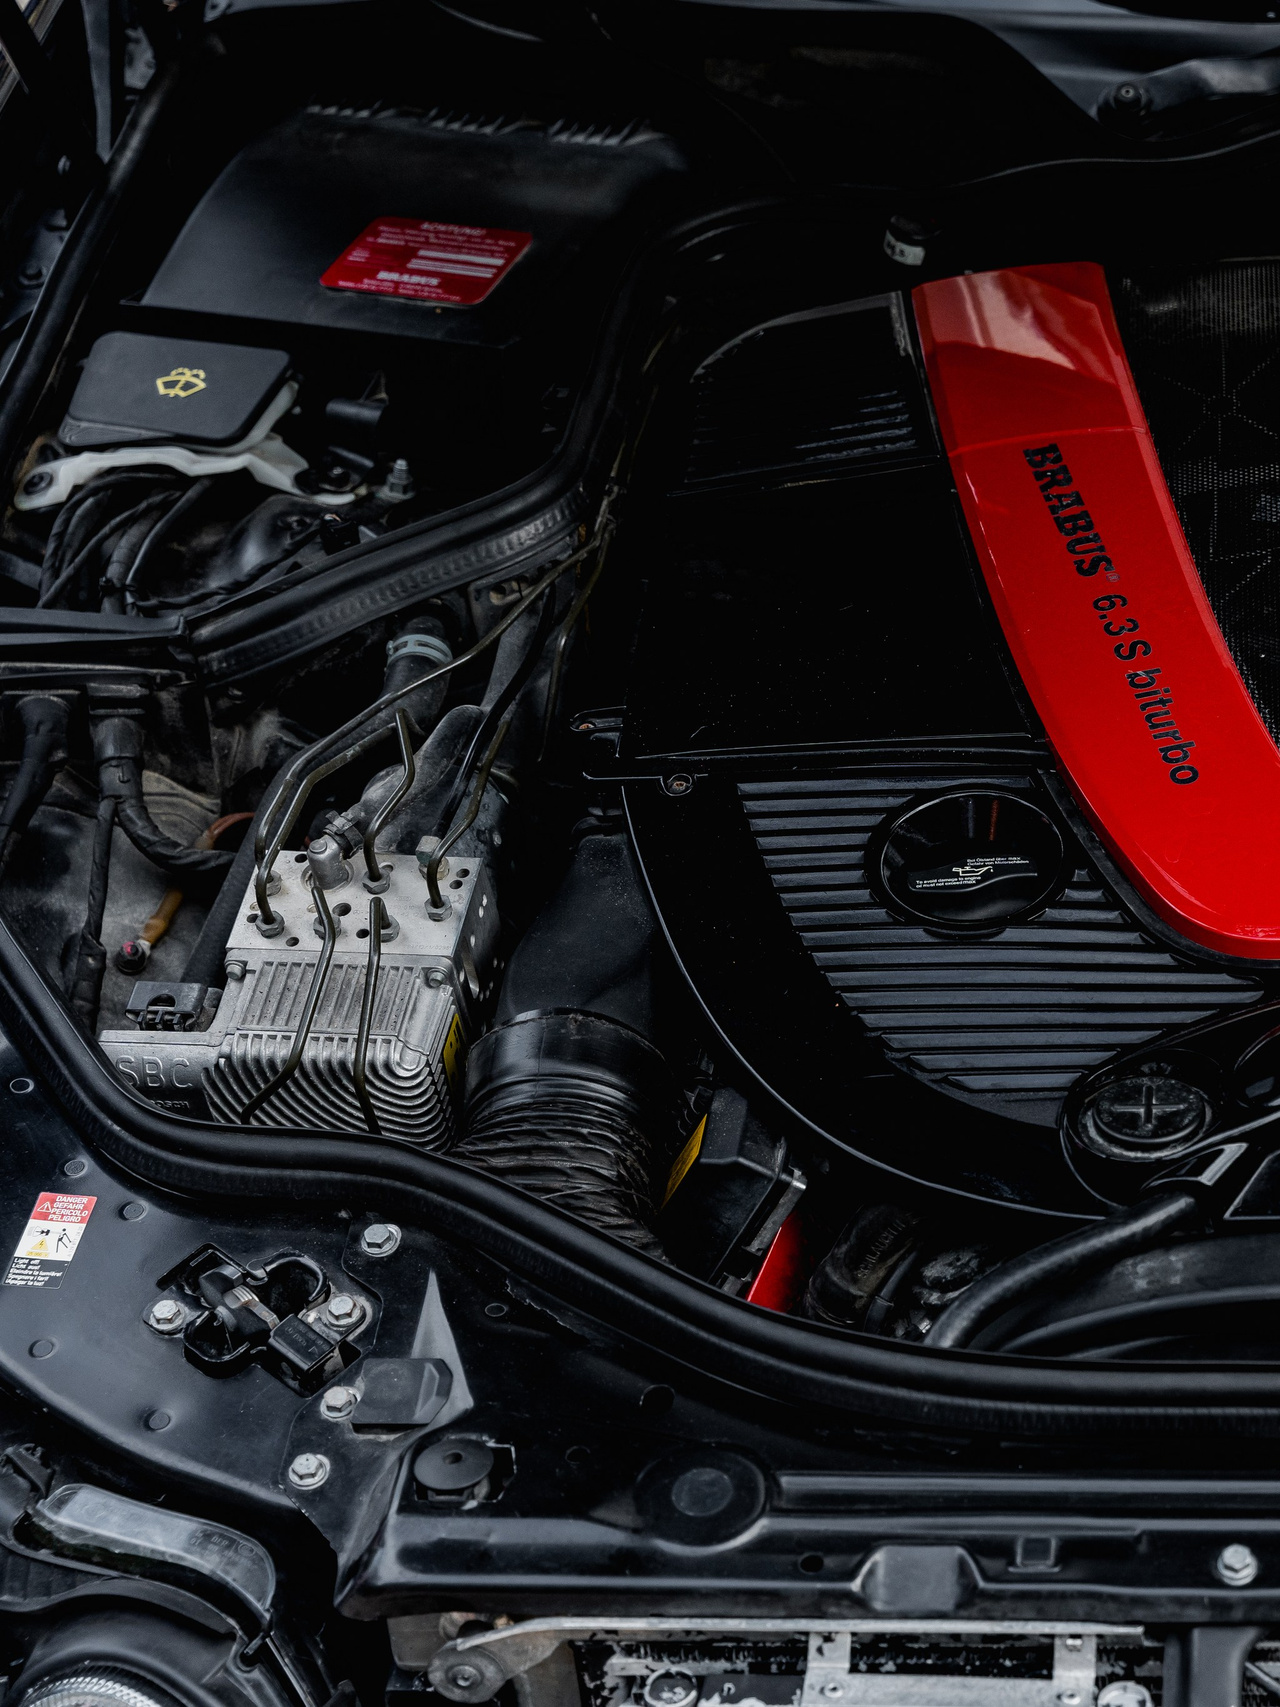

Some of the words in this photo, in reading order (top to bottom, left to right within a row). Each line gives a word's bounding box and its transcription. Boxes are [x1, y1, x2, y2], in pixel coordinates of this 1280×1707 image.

[1092, 593, 1140, 637] 6.3
[1113, 639, 1152, 661] S
[1124, 667, 1199, 785] biturbo
[116, 1055, 193, 1088] SBC
[53, 1202, 85, 1210] GEFAHR
[56, 1195, 88, 1204] DANGER
[47, 1214, 82, 1223] PELIGRO
[50, 1208, 88, 1217] PERICOLO
